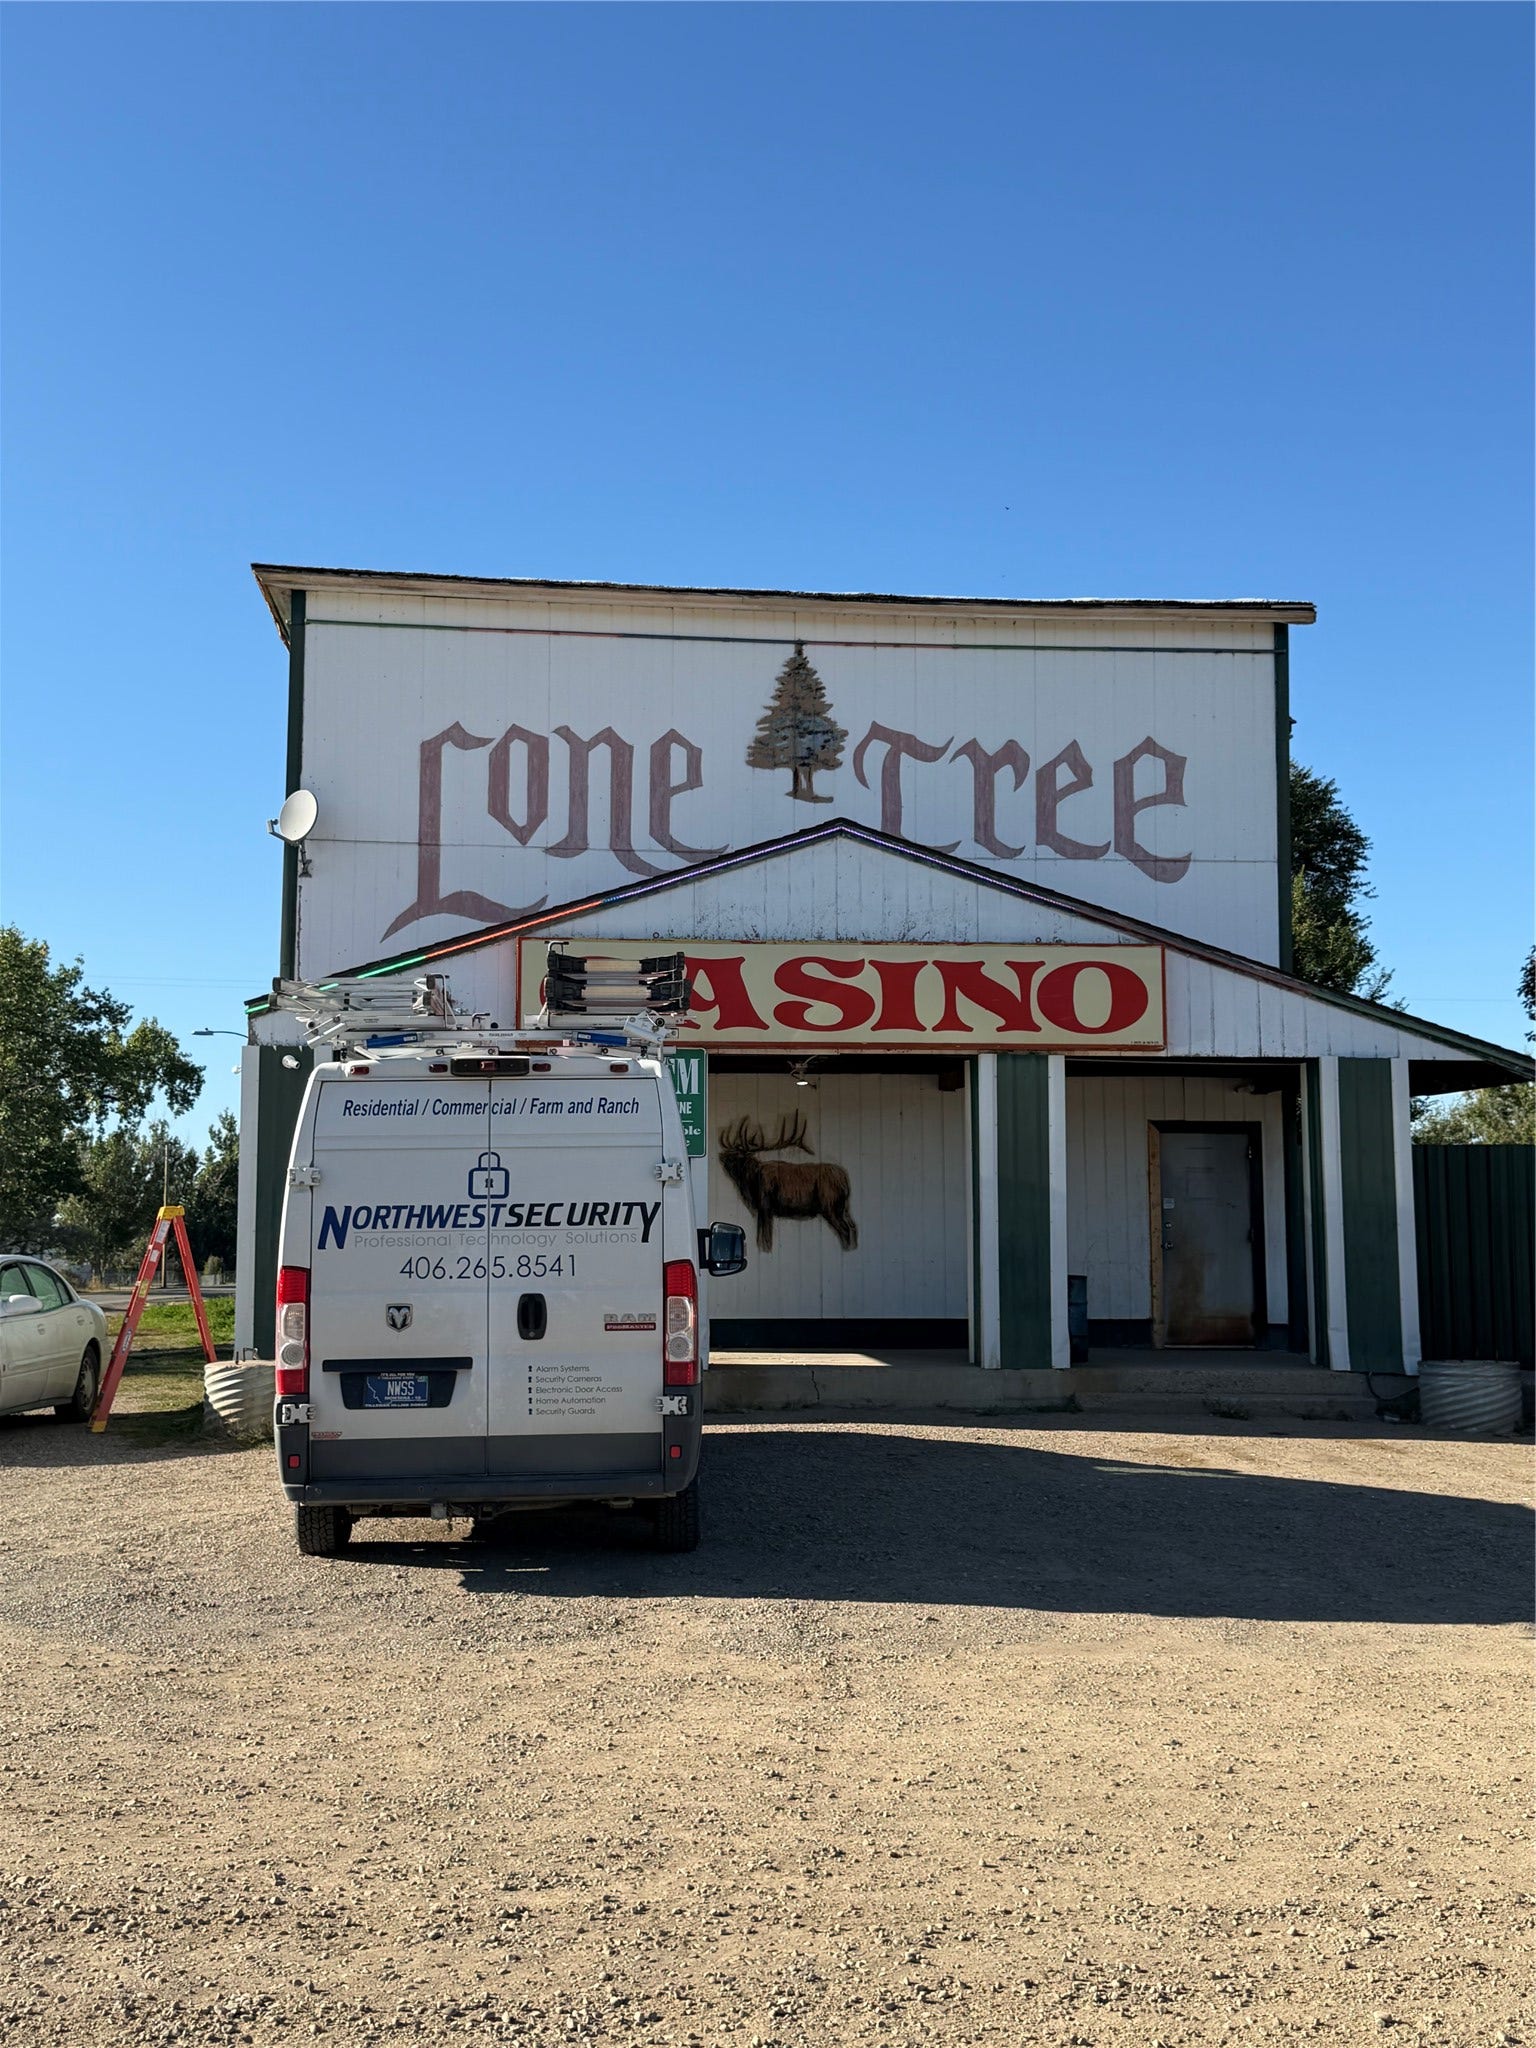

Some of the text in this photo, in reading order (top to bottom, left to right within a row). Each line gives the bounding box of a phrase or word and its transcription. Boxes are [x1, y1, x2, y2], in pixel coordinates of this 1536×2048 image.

[380, 720, 1192, 942] Lone Tree
[540, 954, 1149, 1035] ASINO
[342, 1099, 420, 1117] Residential
[432, 1098, 517, 1116] Commercial
[529, 1097, 564, 1114] Farm
[567, 1097, 594, 1114] and
[596, 1096, 640, 1114] Ranch
[354, 1230, 638, 1248] Professional Technology Solutions
[399, 1254, 576, 1280] 406.265.8541
[603, 1312, 657, 1322] RAM
[536, 1364, 590, 1374] Alarm Systems
[535, 1375, 602, 1384] Security Cameras
[387, 1380, 415, 1396] NWSS
[535, 1385, 623, 1394] Electronic Door Access
[536, 1396, 606, 1405] Home Automation
[535, 1406, 596, 1416] Security Guards
